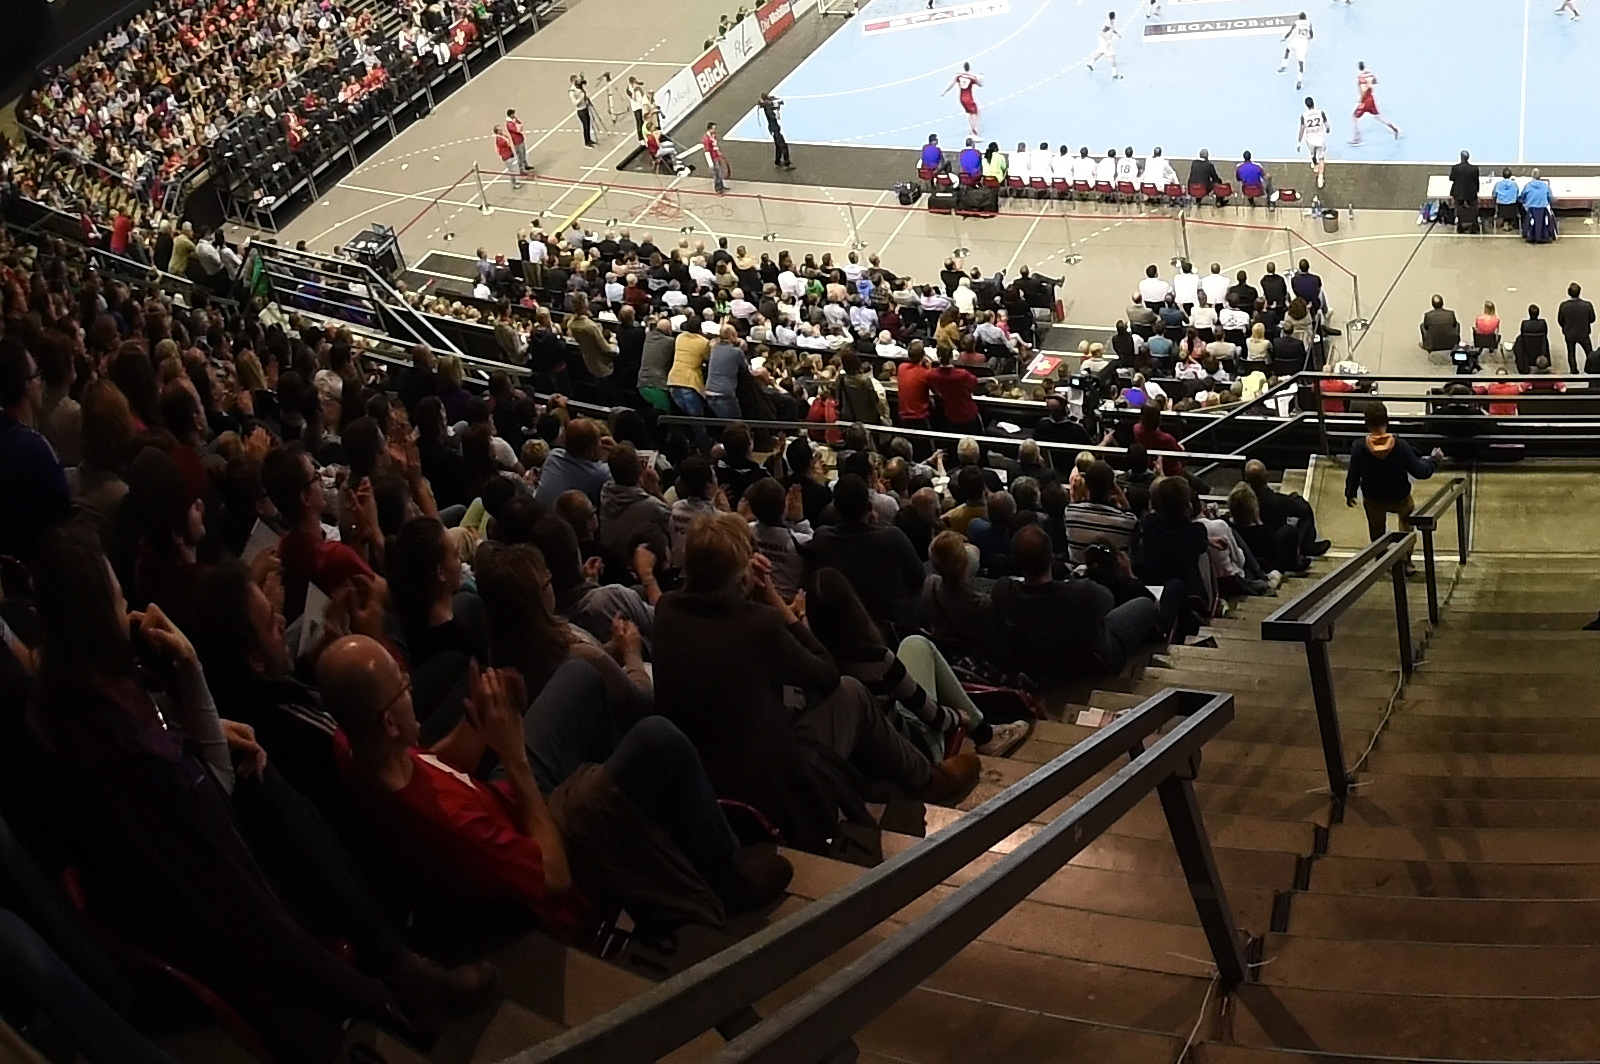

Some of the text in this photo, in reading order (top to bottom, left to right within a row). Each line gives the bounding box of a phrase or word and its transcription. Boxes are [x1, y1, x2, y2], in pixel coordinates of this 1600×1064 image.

[1166, 18, 1286, 34] LEGALJOB.ch
[696, 59, 727, 97] Blick
[1306, 117, 1321, 128] 22
